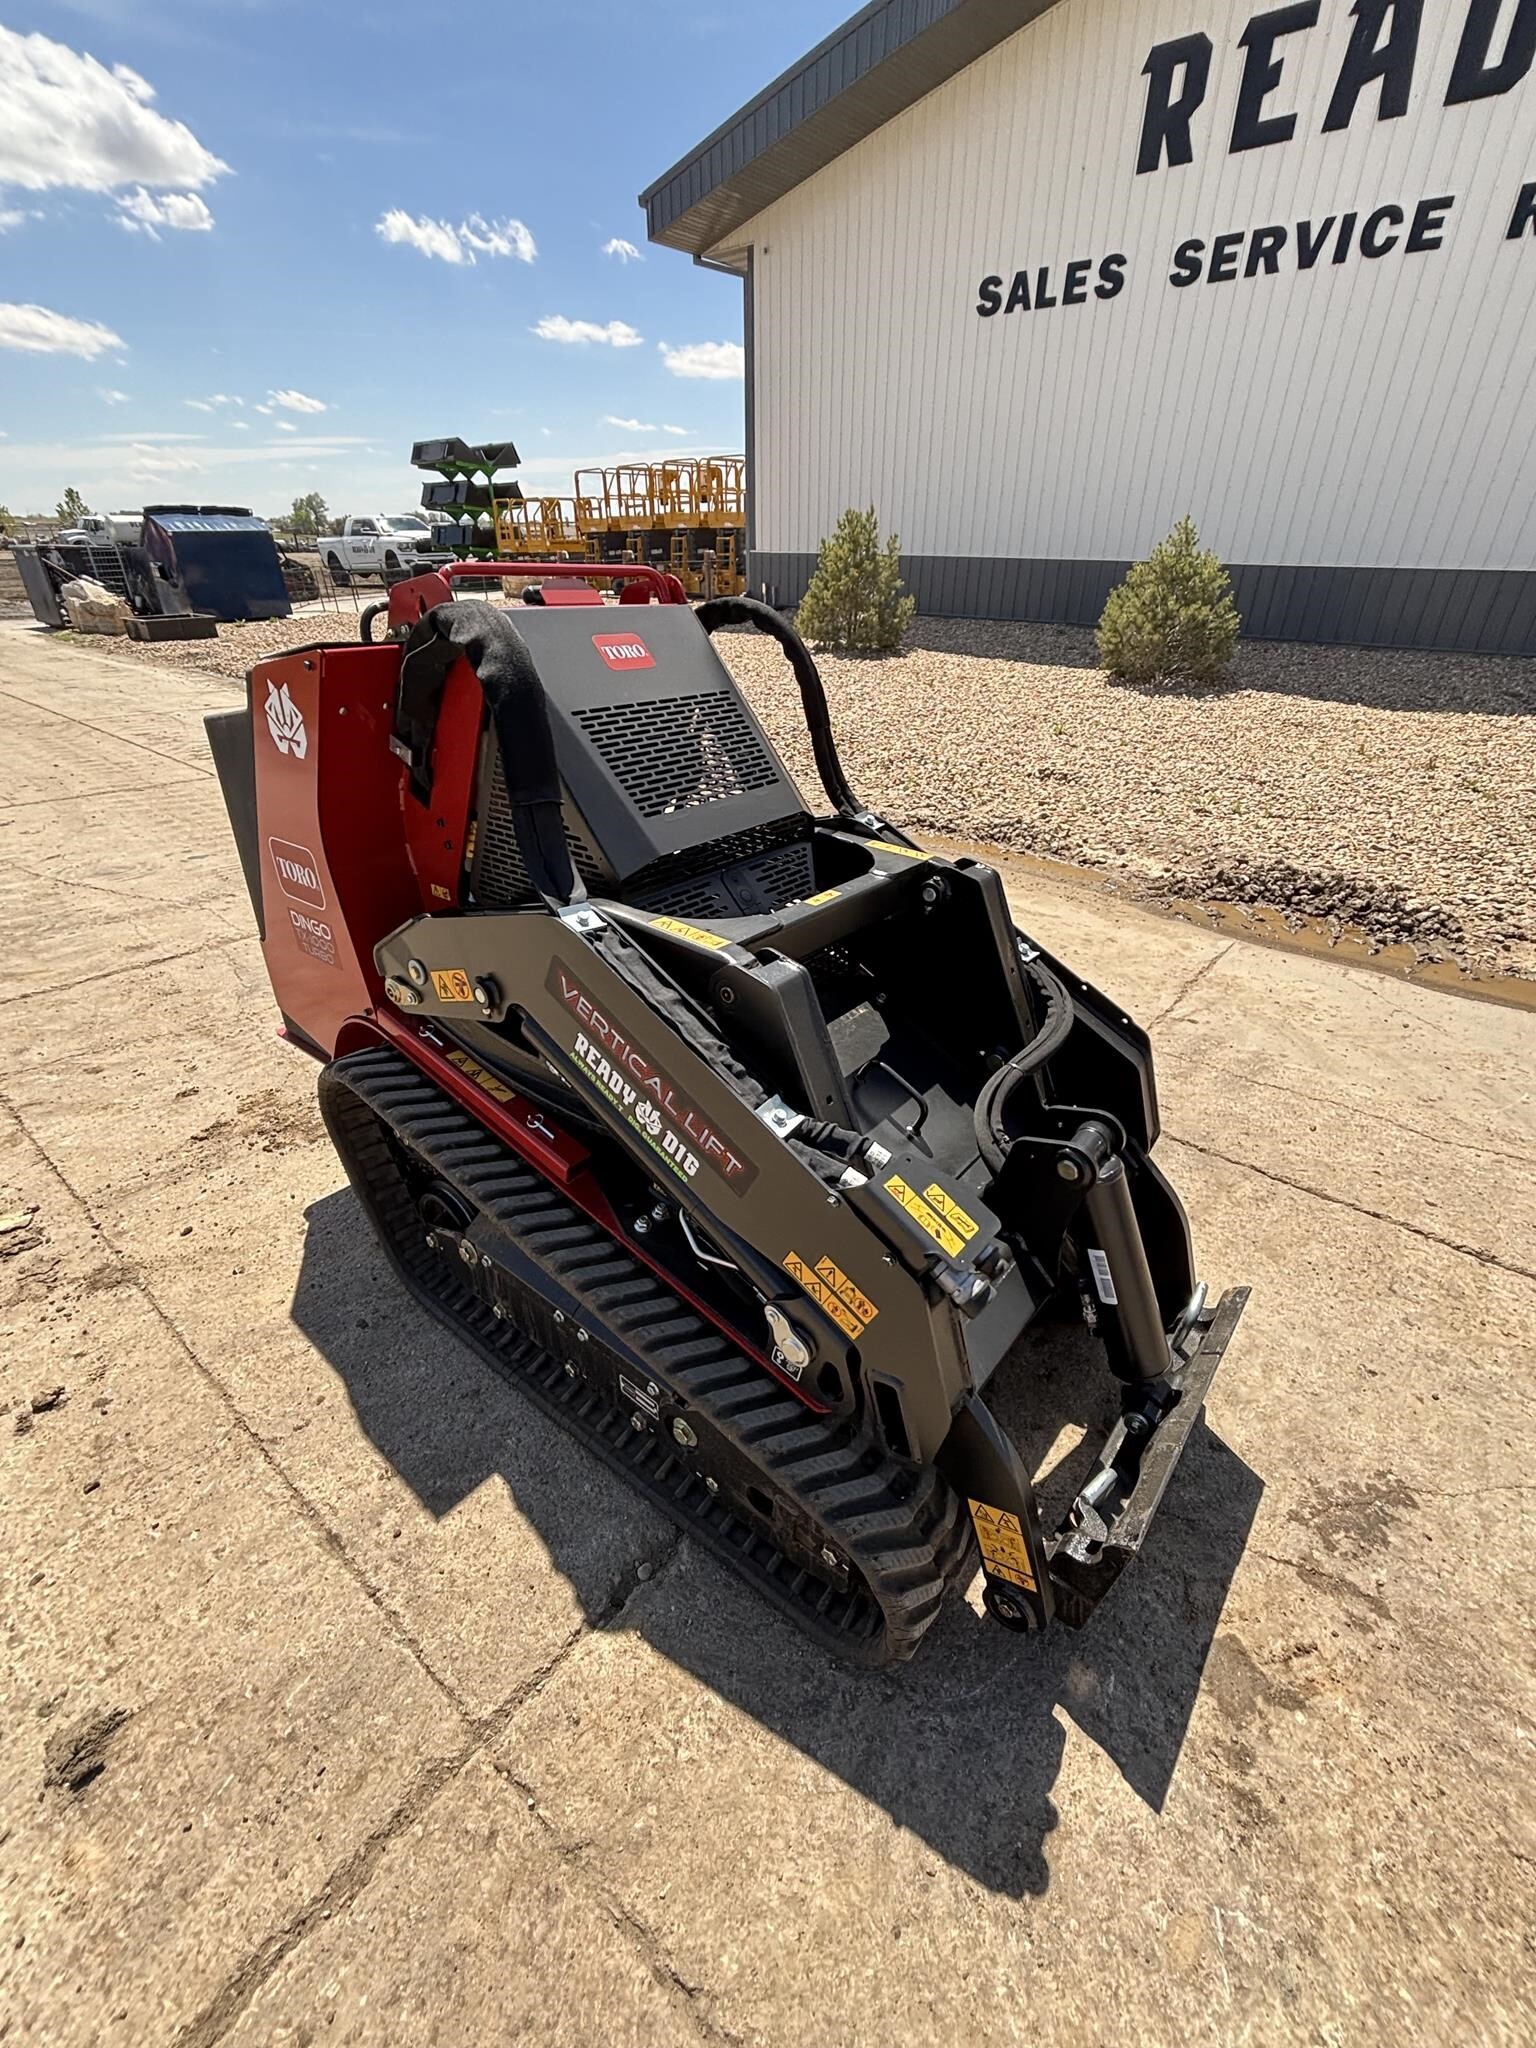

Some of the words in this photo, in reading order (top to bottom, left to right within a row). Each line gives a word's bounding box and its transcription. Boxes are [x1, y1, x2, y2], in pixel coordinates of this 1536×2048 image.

[976, 253, 1128, 317] SALES
[1169, 195, 1456, 287] SERVICE
[600, 643, 647, 660] TORO
[276, 856, 318, 889] TORO
[289, 910, 332, 940] DINGO
[561, 975, 678, 1117] VERTICAL
[684, 1112, 742, 1172] LIFT
[574, 1032, 637, 1106] READY
[661, 1129, 700, 1176] DIG
